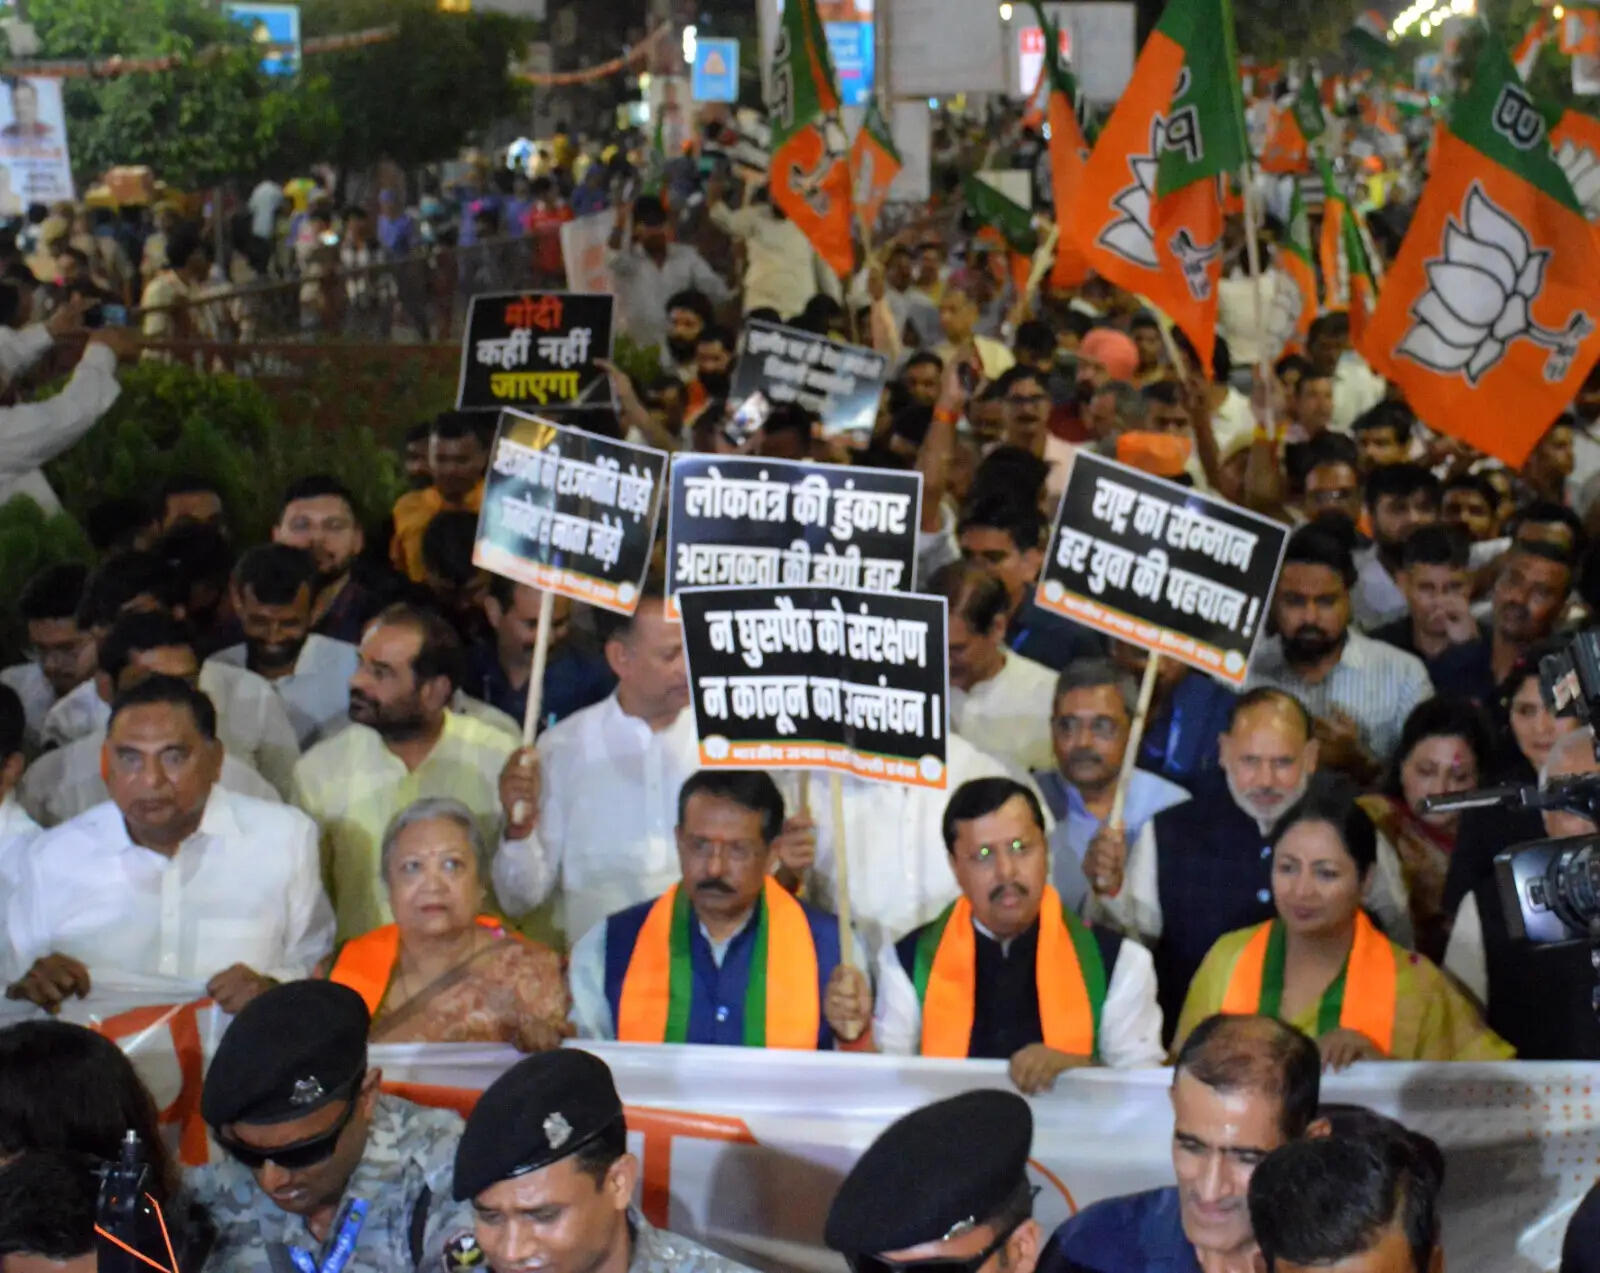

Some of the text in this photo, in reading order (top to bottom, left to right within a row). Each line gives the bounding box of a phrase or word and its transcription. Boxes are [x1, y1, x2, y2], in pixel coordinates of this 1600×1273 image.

[476, 327, 592, 370] कहीं नहीं
[490, 371, 580, 405] जाएगा
[683, 465, 790, 522] लोकतंत्र
[791, 474, 831, 527] की
[675, 543, 781, 585] अराजकता
[781, 538, 813, 585] की
[1133, 492, 1170, 541] का
[1166, 503, 1259, 573] सम्मान
[1056, 525, 1093, 573] हर
[1087, 539, 1136, 594] युवा
[1131, 549, 1170, 602] की
[1166, 567, 1249, 632] पहचान
[704, 596, 928, 669] न घुसपैठ को संरक्षण
[699, 676, 729, 719] न
[727, 675, 809, 734] कानून
[808, 676, 843, 723] का
